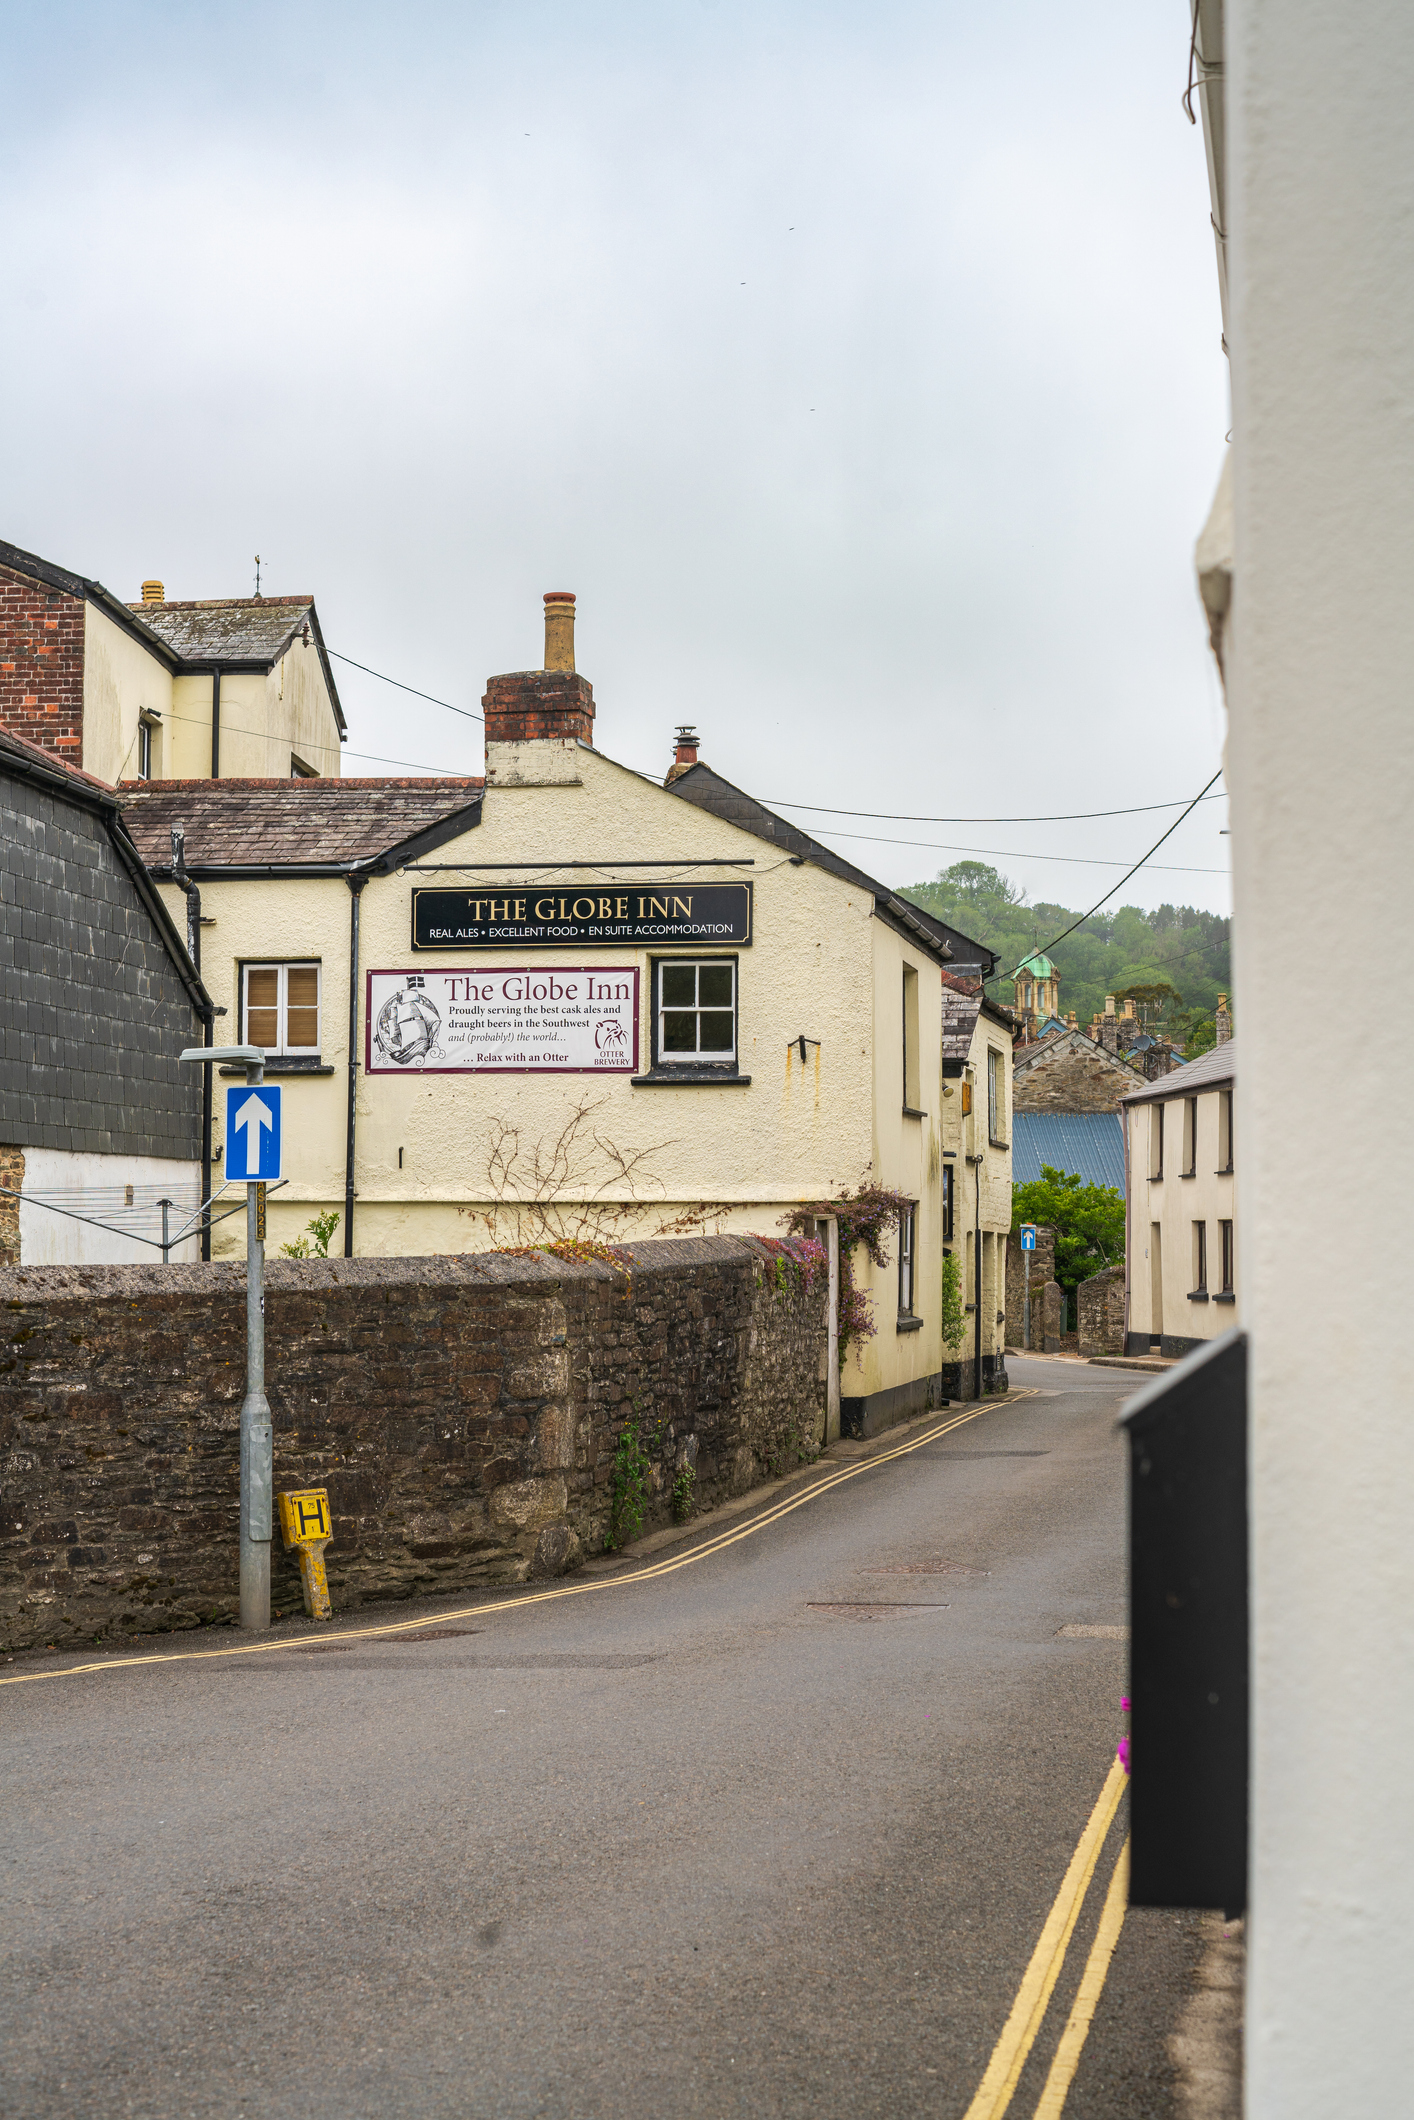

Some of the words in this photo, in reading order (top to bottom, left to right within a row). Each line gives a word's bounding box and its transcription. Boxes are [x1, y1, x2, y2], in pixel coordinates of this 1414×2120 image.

[468, 898, 527, 921] THE
[535, 896, 629, 922] GLOBE
[636, 896, 694, 919] INN
[429, 928, 454, 938] REAL
[455, 928, 479, 938] ALES
[489, 927, 545, 937] EXCELLENT
[547, 926, 578, 936] FOOD
[588, 926, 603, 936] EN
[605, 925, 633, 935] SUITE
[634, 924, 733, 935] ACCOMMODATION
[444, 977, 494, 1001] The
[502, 976, 578, 1001] Globe
[586, 977, 631, 1000] Inn
[449, 1005, 485, 1016] Proudly
[487, 1006, 522, 1016] serving
[523, 1005, 539, 1014] the
[540, 1005, 560, 1014] best
[561, 1005, 582, 1014] cask
[583, 1005, 602, 1014] ales
[603, 1005, 621, 1014] and
[448, 1020, 485, 1030] draught
[487, 1019, 512, 1028] beers
[513, 1019, 523, 1028] in
[525, 1019, 541, 1028] the
[542, 1018, 590, 1028] Southwest
[448, 1033, 465, 1042] and
[467, 1032, 515, 1044] (probably!)
[516, 1032, 531, 1041] the
[476, 1053, 503, 1062] Relax
[505, 1053, 526, 1062] with
[528, 1054, 541, 1062] an
[542, 1052, 569, 1061] Otter
[594, 1058, 630, 1066] BREWERY
[297, 1499, 325, 1536] H
